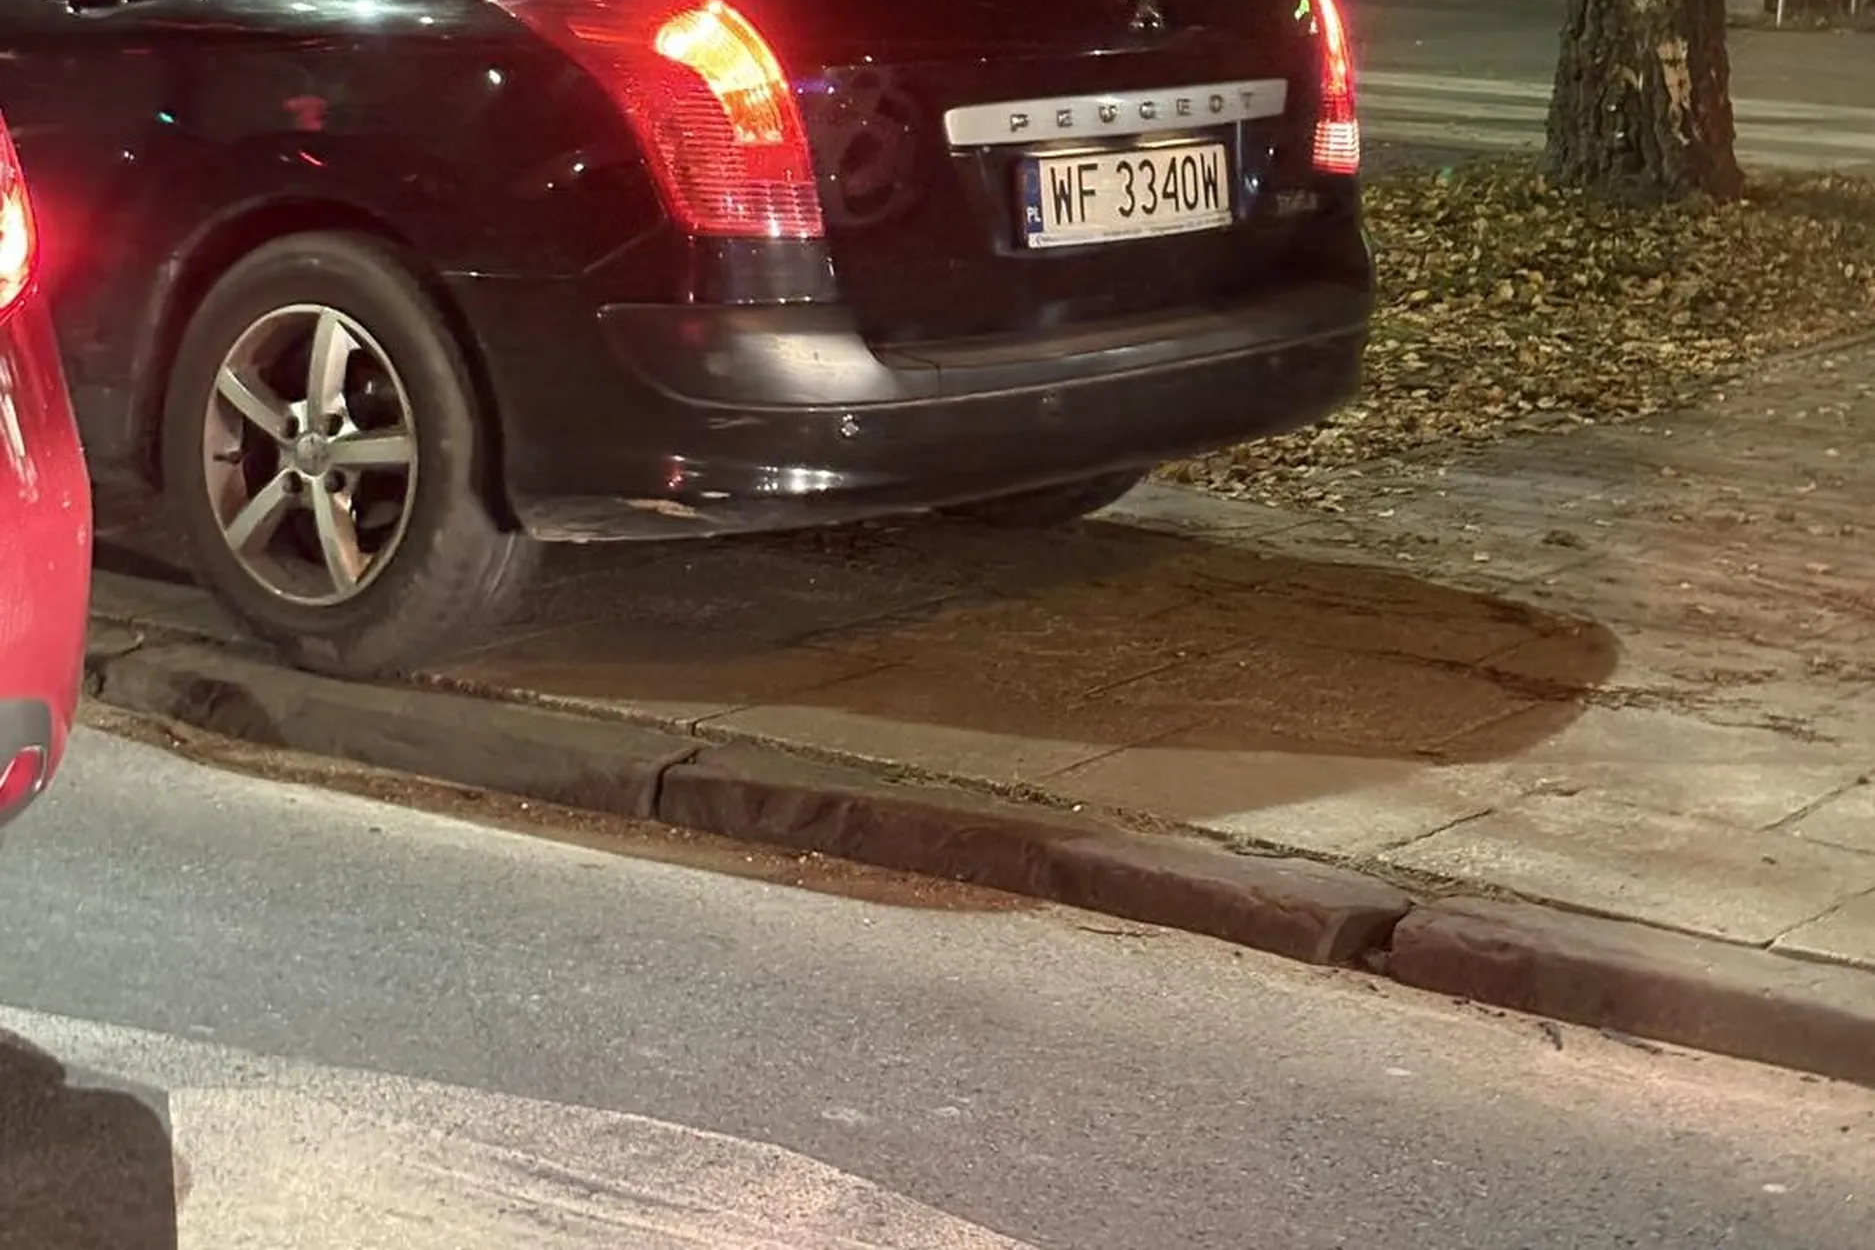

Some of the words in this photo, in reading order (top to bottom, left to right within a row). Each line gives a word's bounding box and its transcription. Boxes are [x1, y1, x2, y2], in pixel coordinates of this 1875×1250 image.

[1010, 91, 1254, 132] PEUGEOT
[1051, 162, 1098, 225] WF
[1116, 152, 1220, 218] 3340W
